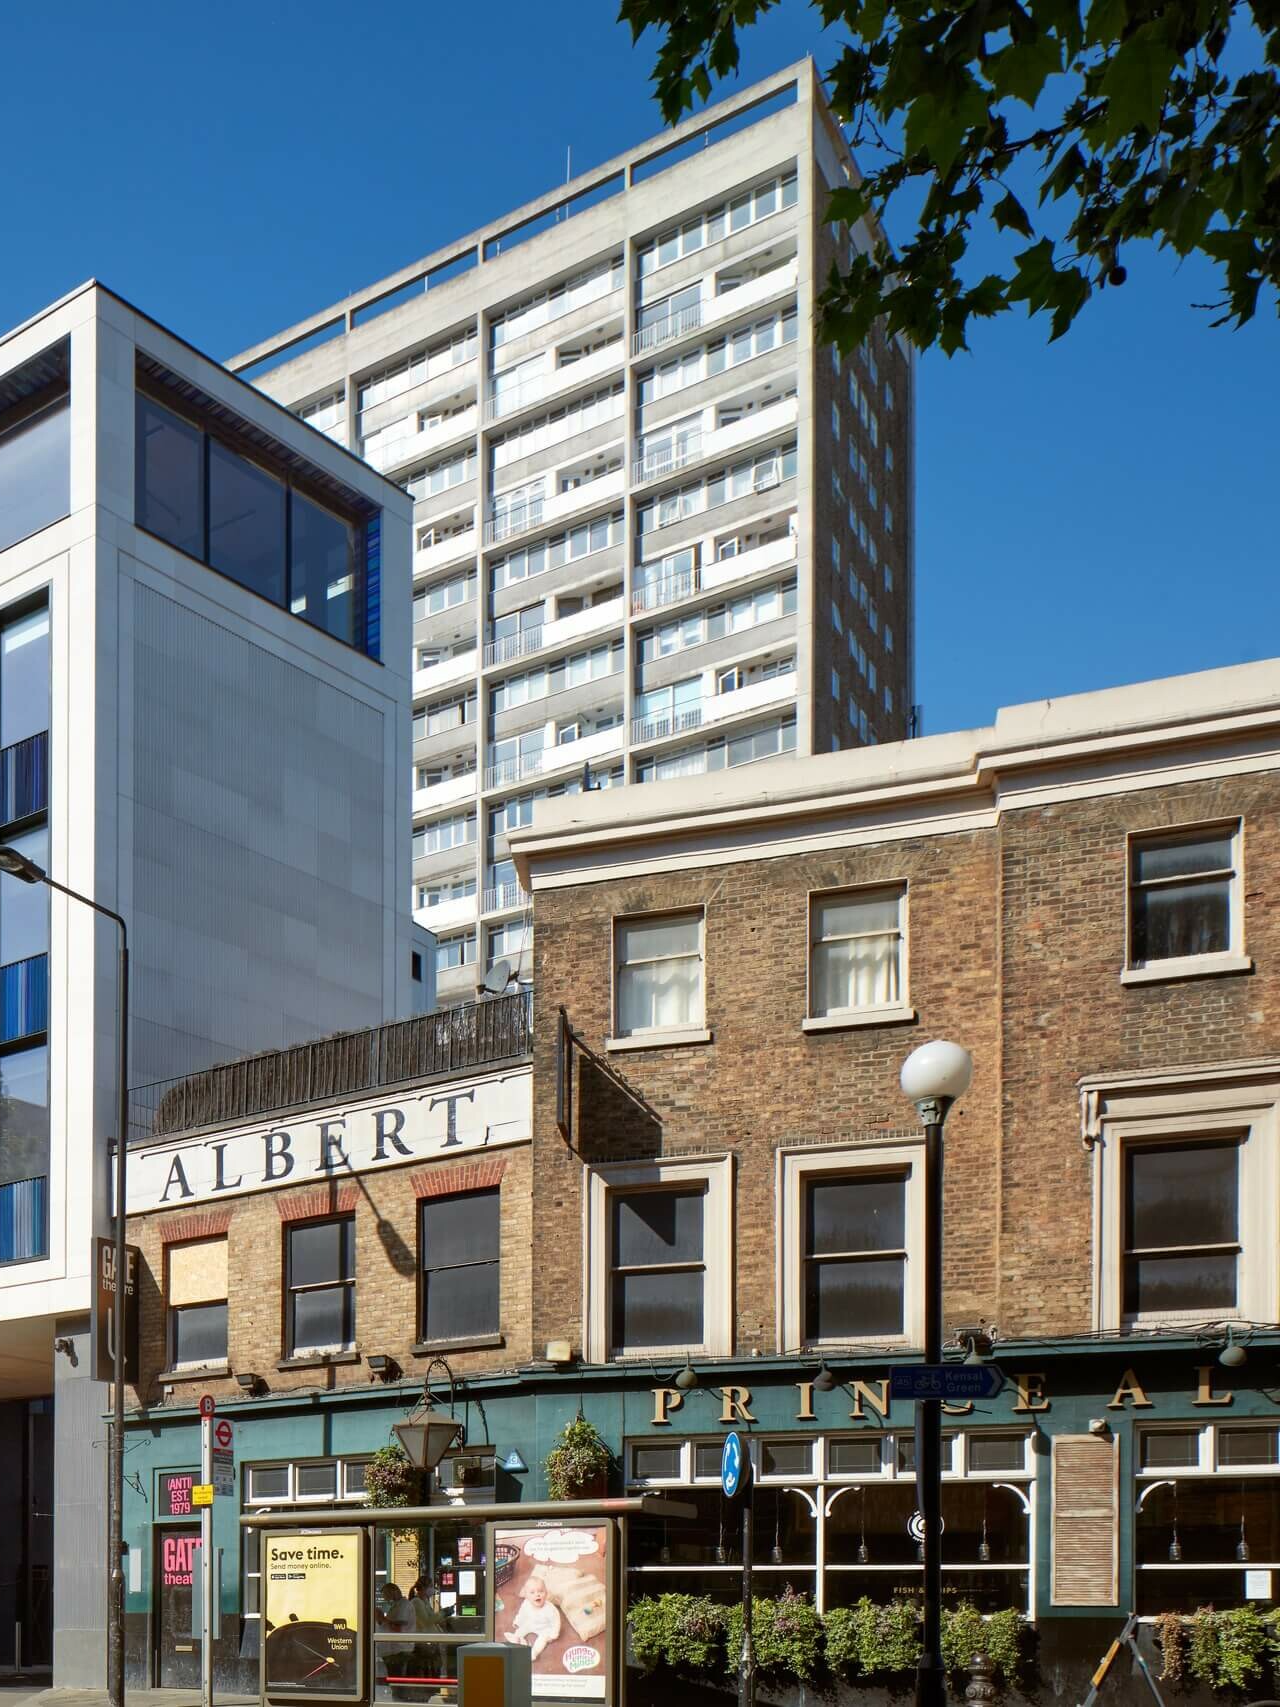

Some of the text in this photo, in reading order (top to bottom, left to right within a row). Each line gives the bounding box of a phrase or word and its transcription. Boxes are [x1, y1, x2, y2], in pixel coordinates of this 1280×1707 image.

[159, 1088, 475, 1203] ALBERT
[102, 1245, 135, 1284] GAE
[102, 1277, 134, 1295] there
[945, 1371, 982, 1381] Kensal
[946, 1383, 981, 1393] Green
[1107, 1365, 1280, 1410] AL
[204, 1398, 212, 1412] B
[171, 1489, 190, 1502] EST.
[170, 1502, 191, 1515] 1979
[164, 1537, 202, 1572] GAT
[271, 1546, 344, 1561] Save time.
[164, 1572, 193, 1585] theat
